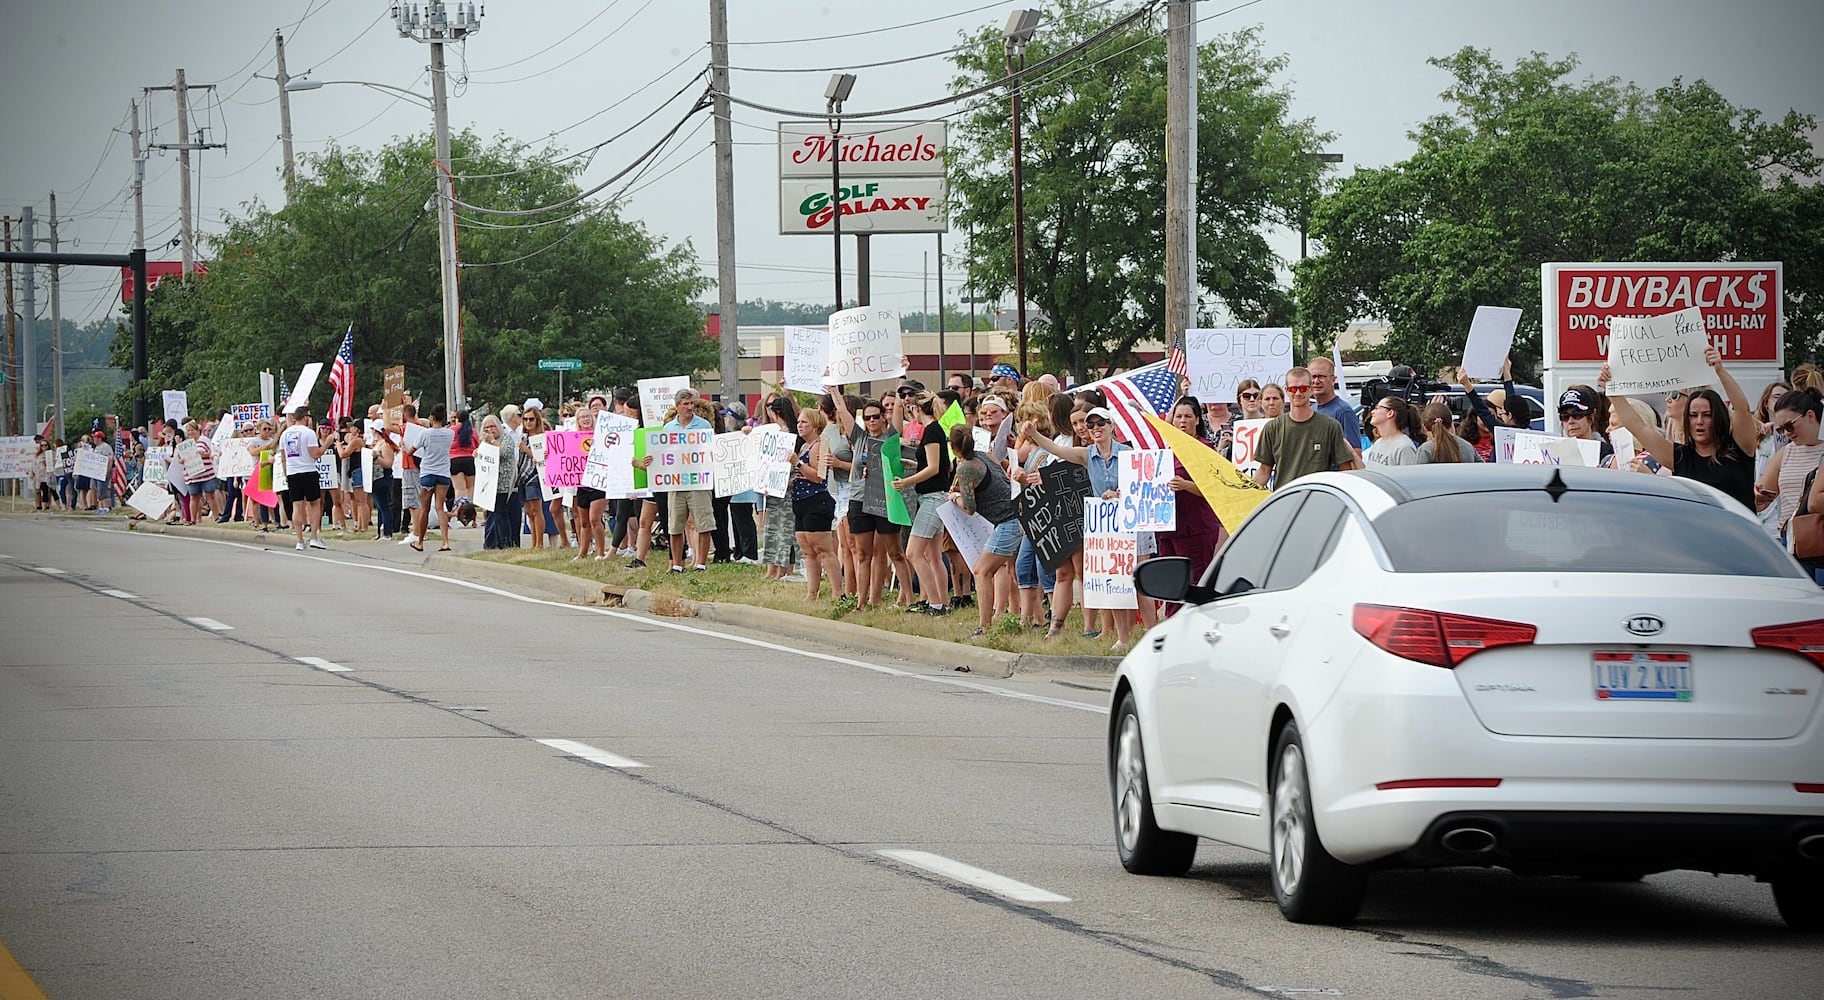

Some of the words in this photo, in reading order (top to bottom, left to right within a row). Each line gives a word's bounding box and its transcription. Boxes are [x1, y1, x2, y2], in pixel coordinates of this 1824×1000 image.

[792, 134, 936, 164] Michaels
[799, 182, 879, 216] GOLF
[806, 197, 931, 229] GALAXY
[1566, 271, 1768, 311] BUYBACK$
[842, 313, 867, 326] STAND
[878, 310, 895, 320] FOR
[831, 327, 889, 348] FREEDOM
[846, 346, 863, 356] NOT
[1620, 342, 1690, 366] FREEDOM
[538, 359, 574, 369] Contemporary
[830, 354, 895, 377] FORCE
[1228, 359, 1265, 373] SAYS
[1608, 377, 1685, 393] #STOPTHEMANDATE
[232, 404, 269, 413] PROTECT
[233, 412, 270, 421] MEDICAL
[600, 420, 633, 434] Mandate
[546, 433, 565, 454] NO
[650, 431, 713, 446] COERCION
[1235, 426, 1258, 465] ST
[661, 453, 675, 466] IS
[681, 451, 705, 465] NOT
[1131, 450, 1164, 481] 40%
[724, 459, 746, 477] THE
[548, 472, 583, 487] VACCI
[655, 472, 710, 486] CONSENT
[1085, 552, 1107, 574] BILL
[1109, 553, 1134, 575] 248
[1106, 578, 1134, 595] Freedom
[1596, 665, 1628, 689] LUV
[1637, 665, 1647, 689] 2
[1655, 665, 1688, 690] KUT
